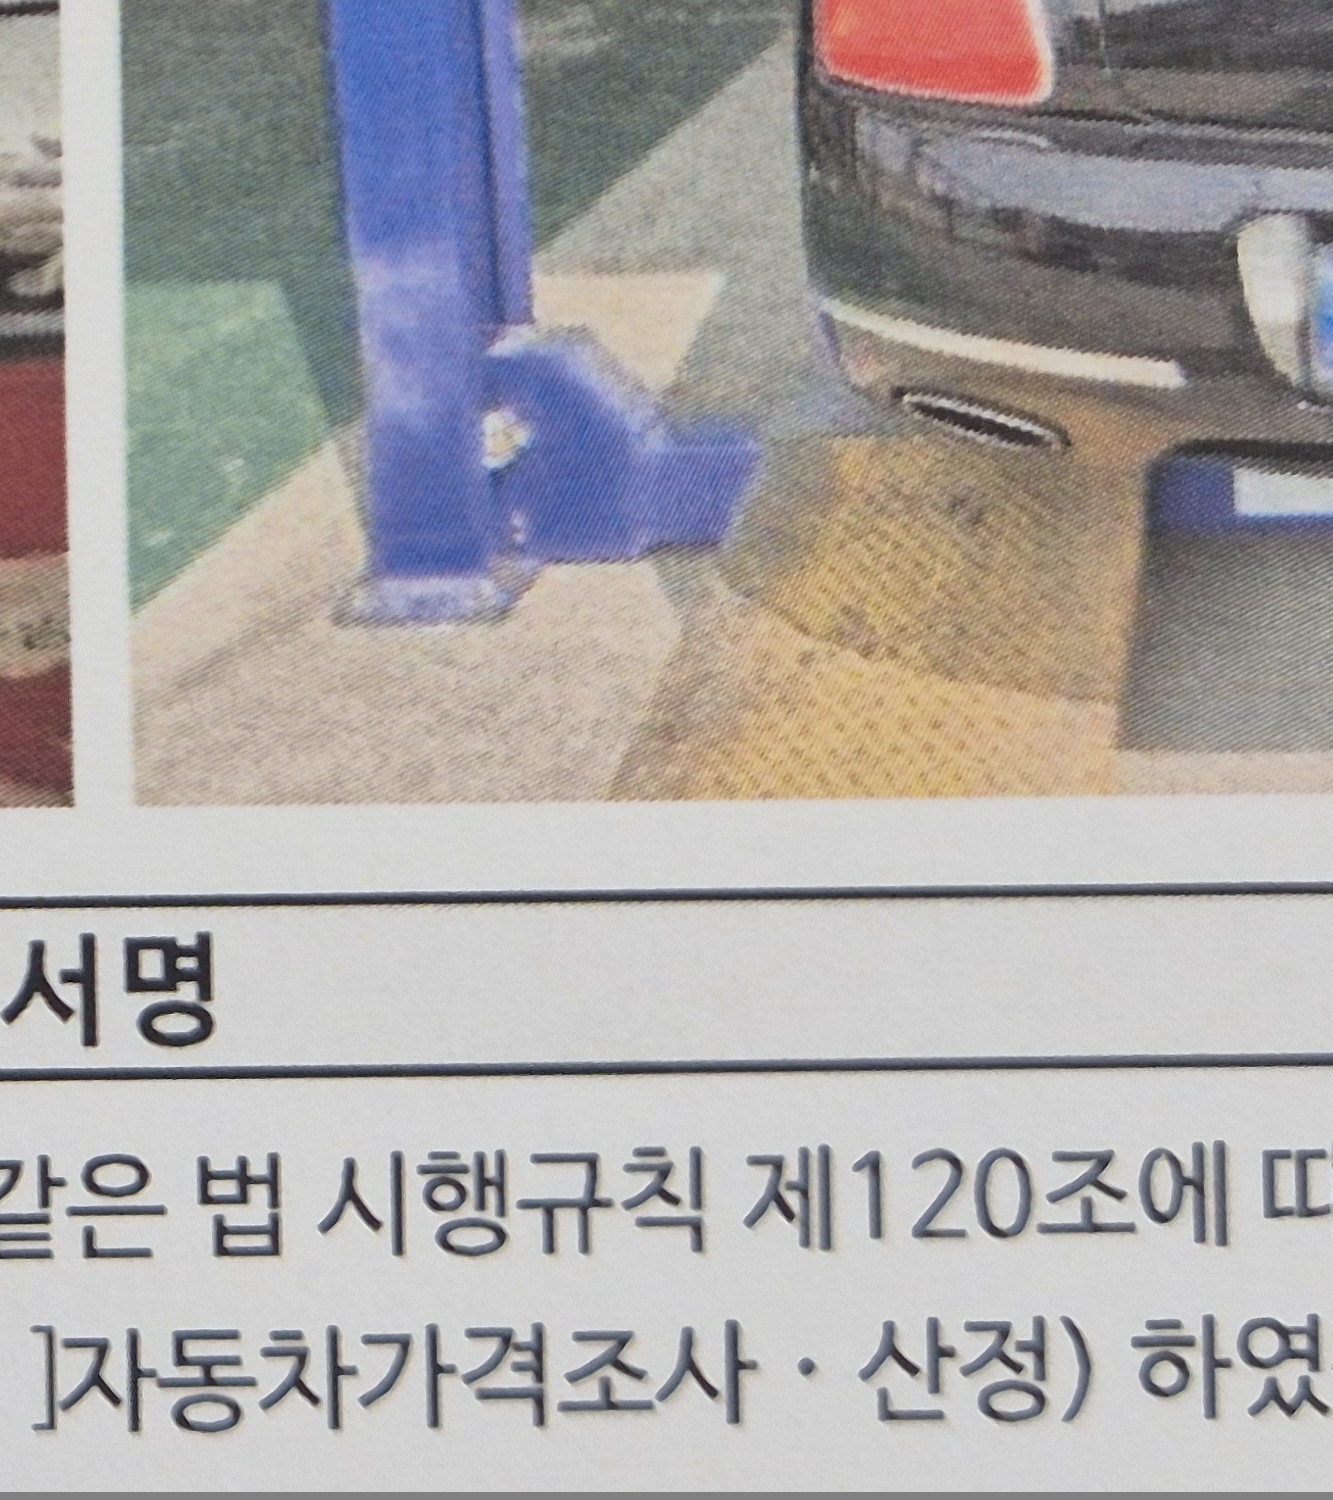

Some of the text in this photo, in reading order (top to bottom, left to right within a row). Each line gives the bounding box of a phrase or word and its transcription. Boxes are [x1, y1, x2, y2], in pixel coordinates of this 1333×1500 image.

[0, 931, 215, 1049] 서명
[197, 1152, 283, 1258] 법
[318, 1146, 705, 1258] 시행규칙
[743, 1139, 1229, 1252] 제120조에
[859, 1315, 1093, 1424] 산정)
